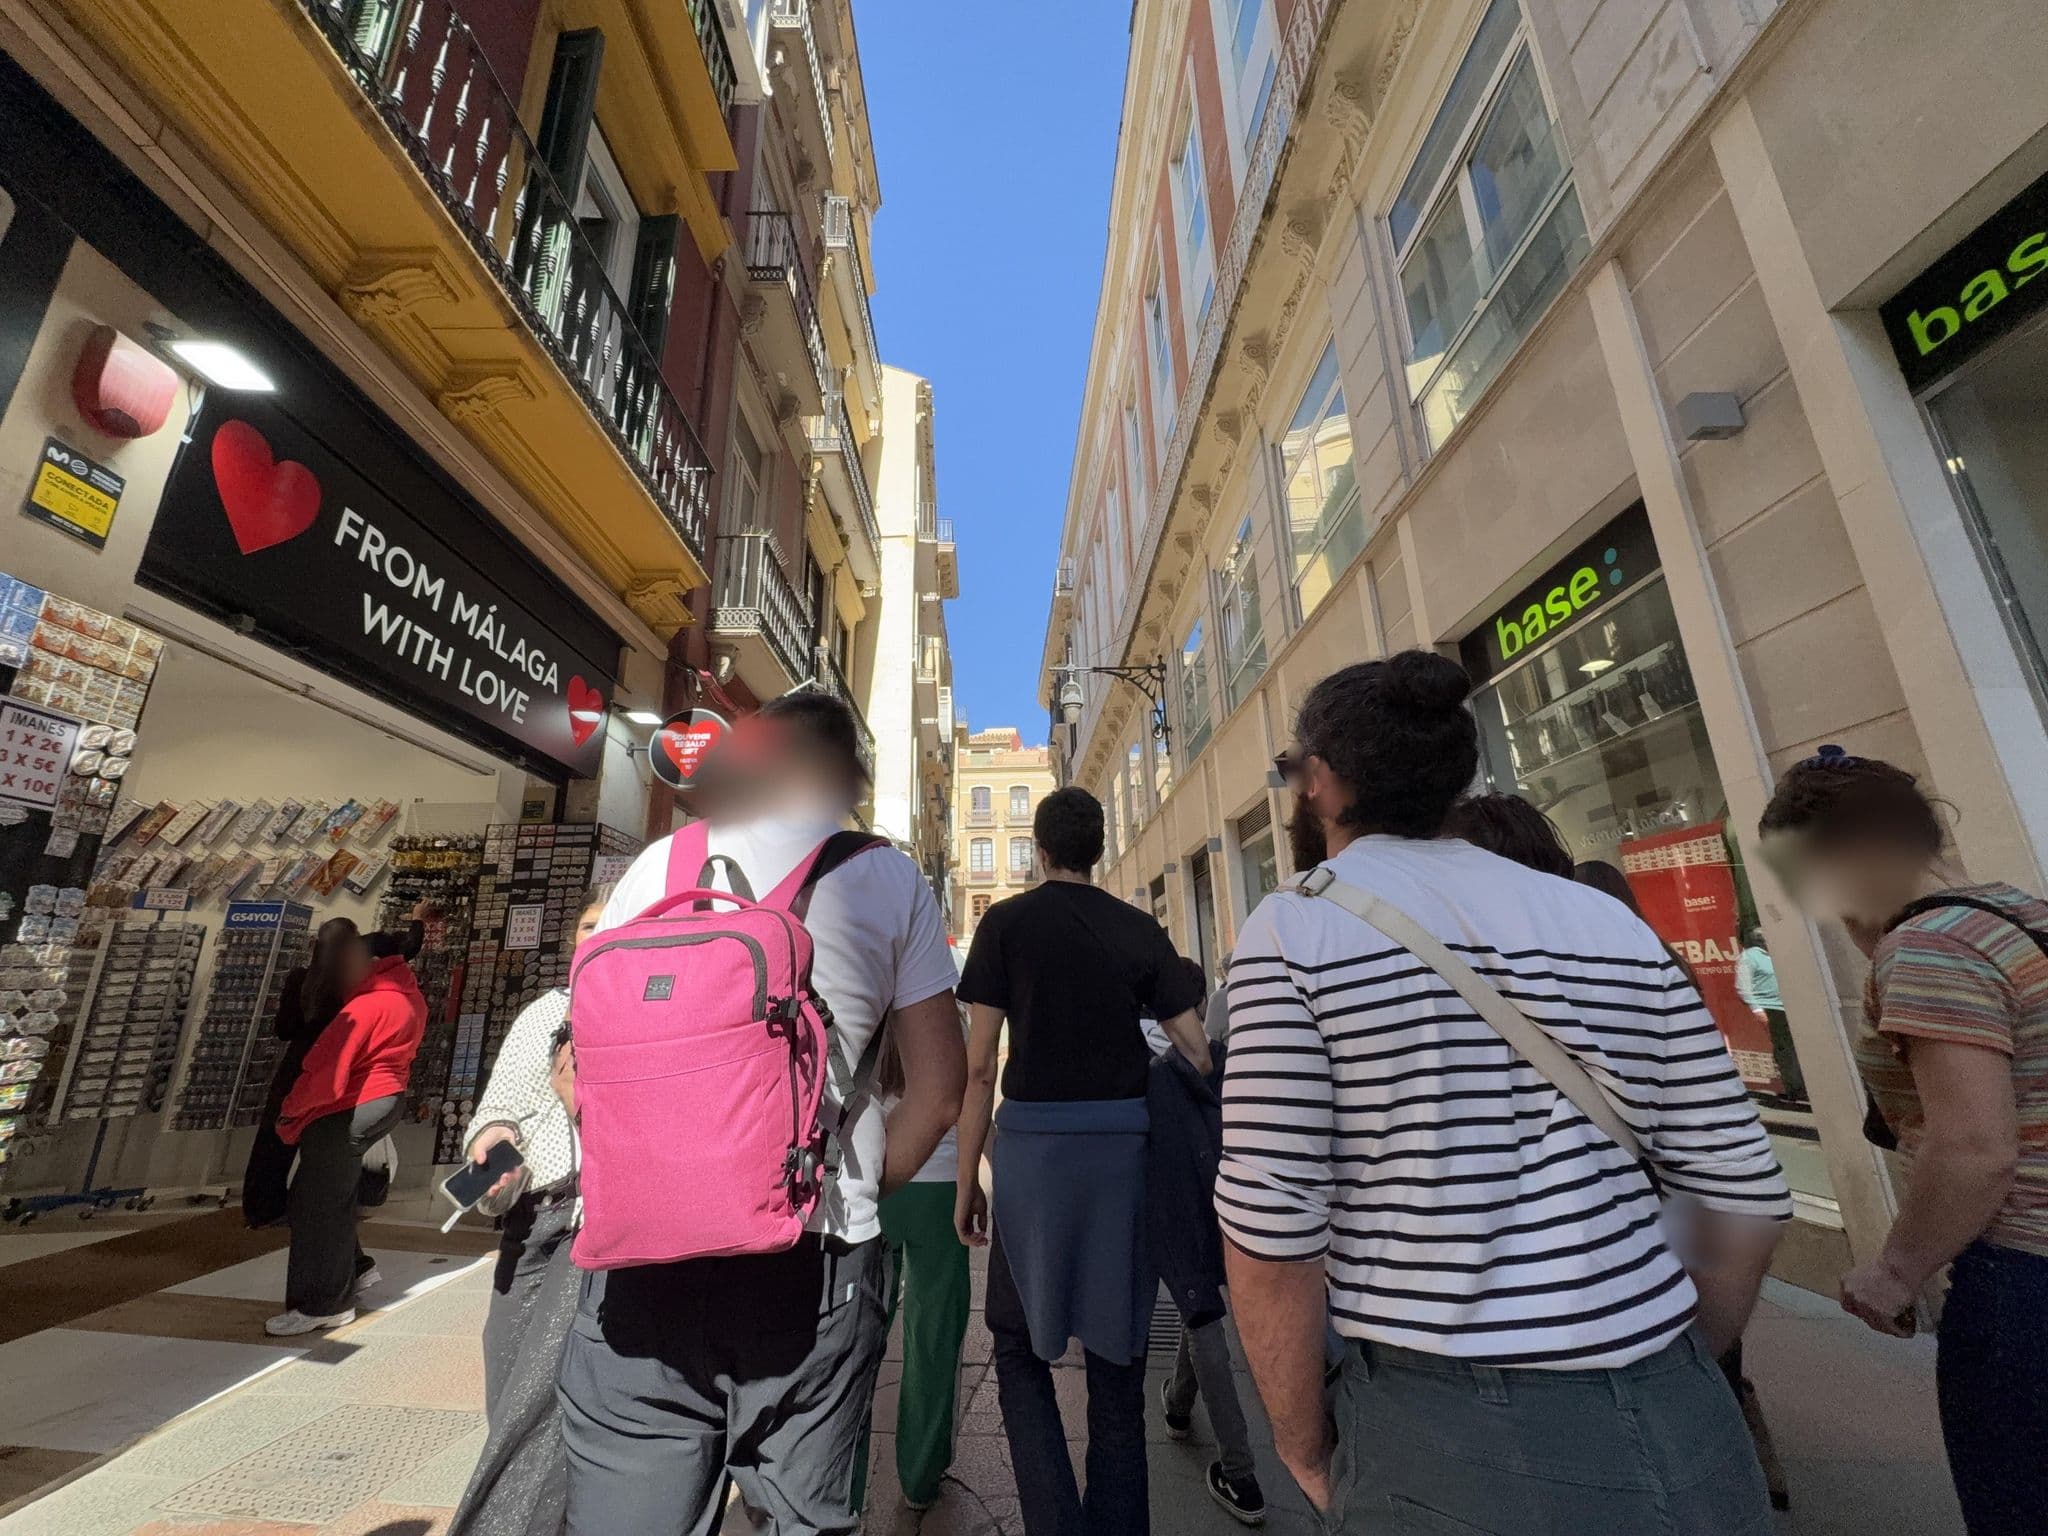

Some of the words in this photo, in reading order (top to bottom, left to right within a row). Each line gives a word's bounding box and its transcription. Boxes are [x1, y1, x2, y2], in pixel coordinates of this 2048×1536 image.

[46, 472, 109, 510] CONECTADA
[334, 506, 445, 612] FROM
[450, 591, 558, 694] MÁLAGA
[364, 593, 454, 681] WITH
[459, 658, 529, 724] LOVE
[9, 711, 65, 737] IMANES
[7, 729, 15, 742] 1
[21, 733, 36, 747] X
[39, 738, 63, 754] 2€
[675, 740, 706, 748] REGALO
[0, 748, 8, 762] 3
[13, 752, 28, 767] X
[33, 757, 56, 773] 5€
[1, 772, 17, 787] X
[23, 777, 55, 796] 10€
[231, 912, 279, 922] GS4YOU
[1695, 966, 1722, 975] TIEMPO
